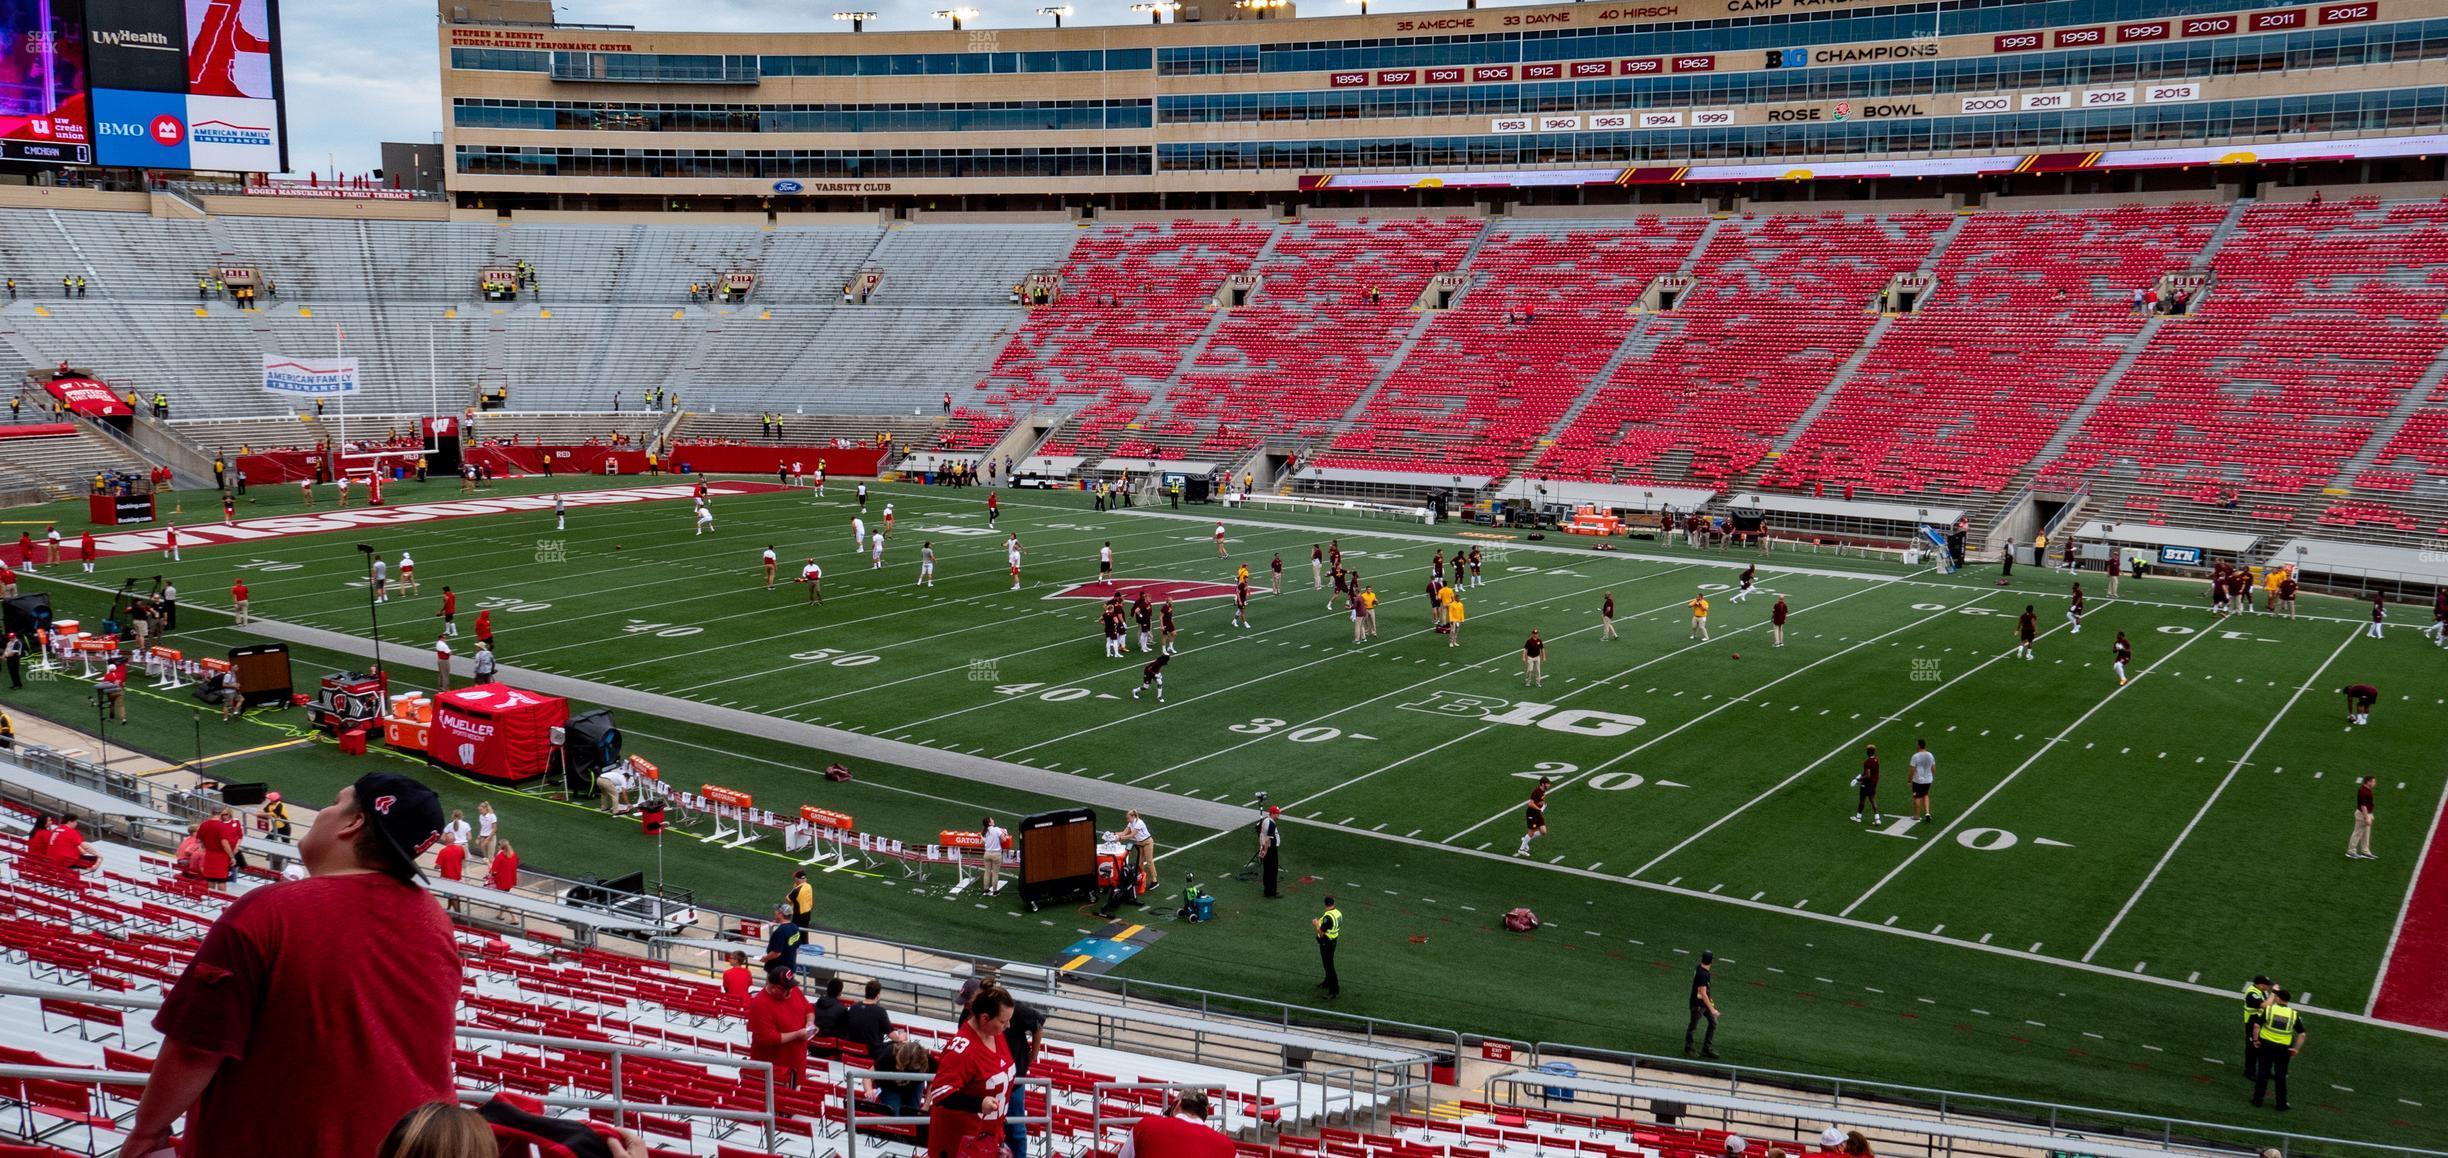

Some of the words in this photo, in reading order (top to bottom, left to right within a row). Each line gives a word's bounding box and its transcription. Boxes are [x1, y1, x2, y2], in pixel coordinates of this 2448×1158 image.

[1503, 16, 1520, 25] 33
[1525, 12, 1570, 24] DAYNE
[1598, 9, 1619, 19] 40
[1623, 6, 1678, 18] HIRSCH
[2327, 6, 2368, 20] 2012
[1397, 22, 1414, 31] 35
[1417, 18, 1475, 30] AMECHE
[2188, 20, 2230, 33] 2010
[2259, 14, 2295, 27] 2011
[452, 29, 491, 38] STEPHEN
[2061, 31, 2098, 43] 1998
[2123, 25, 2162, 38] 1999
[452, 38, 532, 49] STUDENT-ATHLETE
[535, 41, 597, 51] PERFORMANCE
[2001, 36, 2036, 48] 1993
[1816, 43, 1938, 63] CHAMPIONS
[1576, 63, 1606, 74] 1952
[1626, 61, 1657, 72] 1959
[1678, 58, 1709, 69] 1962
[1382, 72, 1411, 83] 1897
[1431, 70, 1457, 81] 1901
[1477, 68, 1508, 79] 1906
[1528, 66, 1554, 77] 1912
[1335, 73, 1364, 84] 1896
[2089, 92, 2126, 103] 2012
[2154, 87, 2191, 99] 2013
[1965, 99, 2007, 110] 2000
[2030, 95, 2061, 107] 2011
[1697, 113, 1728, 123] 1999
[1768, 108, 1821, 122] ROSE
[1863, 104, 1924, 118] BOWL
[1497, 120, 1526, 131] 1953
[1545, 119, 1576, 129] 1960
[1595, 117, 1624, 127] 1963
[1646, 115, 1676, 125] 1994
[99, 122, 144, 137] BMO
[194, 128, 238, 138] AMERICAN
[240, 129, 270, 138] FAMILY
[56, 132, 84, 140] union
[199, 136, 265, 144] INSURANCE
[779, 183, 797, 191] Ford
[816, 183, 861, 191] VARSITY
[863, 183, 891, 191] CLUB
[267, 372, 313, 383] AMERICAN
[316, 374, 351, 382] FAMLY
[37, 483, 748, 552] WISCONSIN
[2163, 547, 2197, 560] BTN
[622, 622, 704, 638] 40
[788, 648, 881, 667] 50
[993, 682, 1091, 701] 40
[444, 714, 494, 736] MUELLER
[1228, 718, 1341, 743] 30
[389, 724, 399, 741] G
[418, 729, 428, 746] G
[1511, 762, 1644, 790] 20
[811, 812, 837, 825] GATORADE
[1865, 813, 2018, 850] 10
[1483, 1041, 1511, 1049] EMERGENCY
